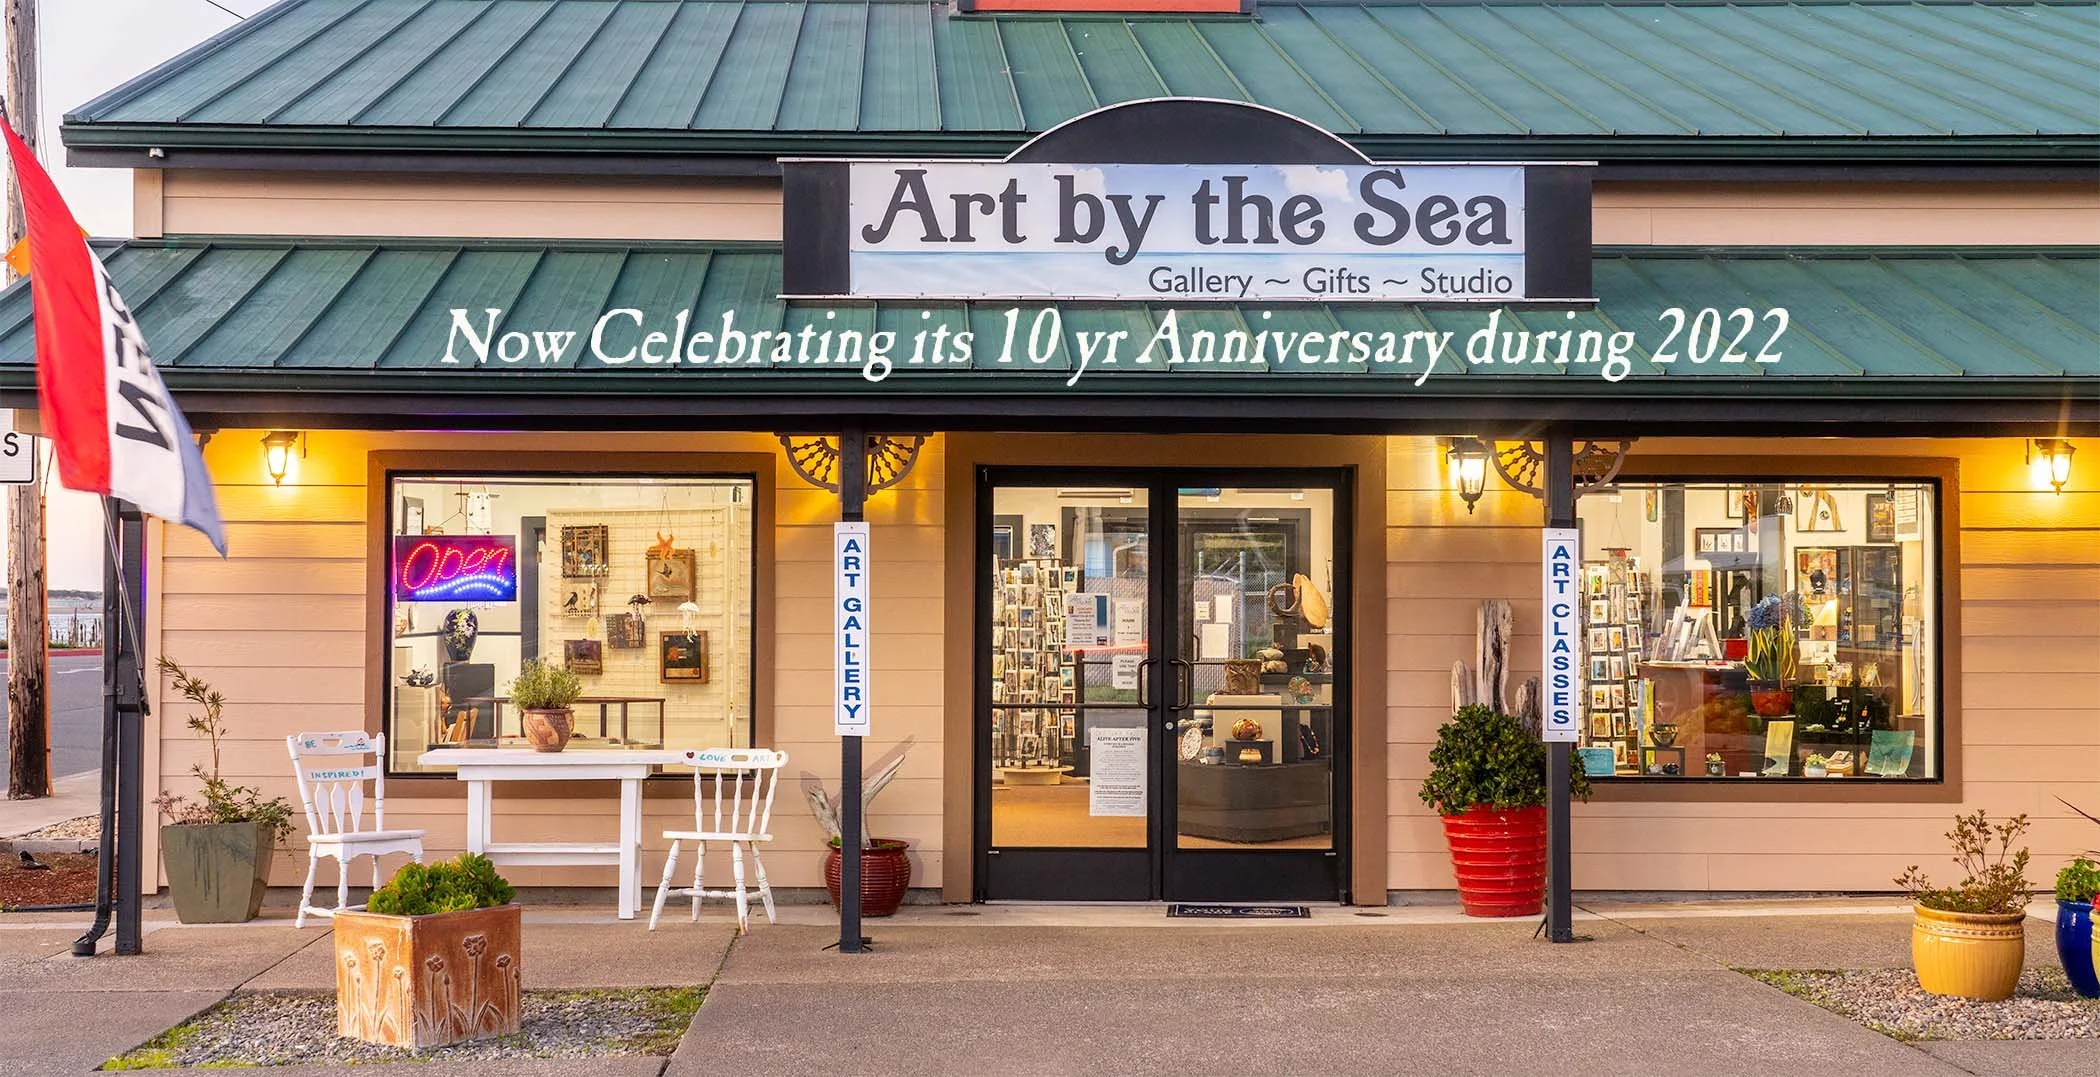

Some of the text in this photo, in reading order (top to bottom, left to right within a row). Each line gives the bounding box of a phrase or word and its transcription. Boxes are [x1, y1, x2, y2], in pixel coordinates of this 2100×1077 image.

[861, 168, 1513, 266] Art by the Sea
[1148, 266, 1253, 298] Gallery
[1303, 267, 1370, 294] Gifts
[1421, 267, 1513, 294] Studio
[402, 542, 509, 591] Open
[843, 538, 862, 719] ART GALLERY
[1551, 545, 1570, 725] ART CLASSES
